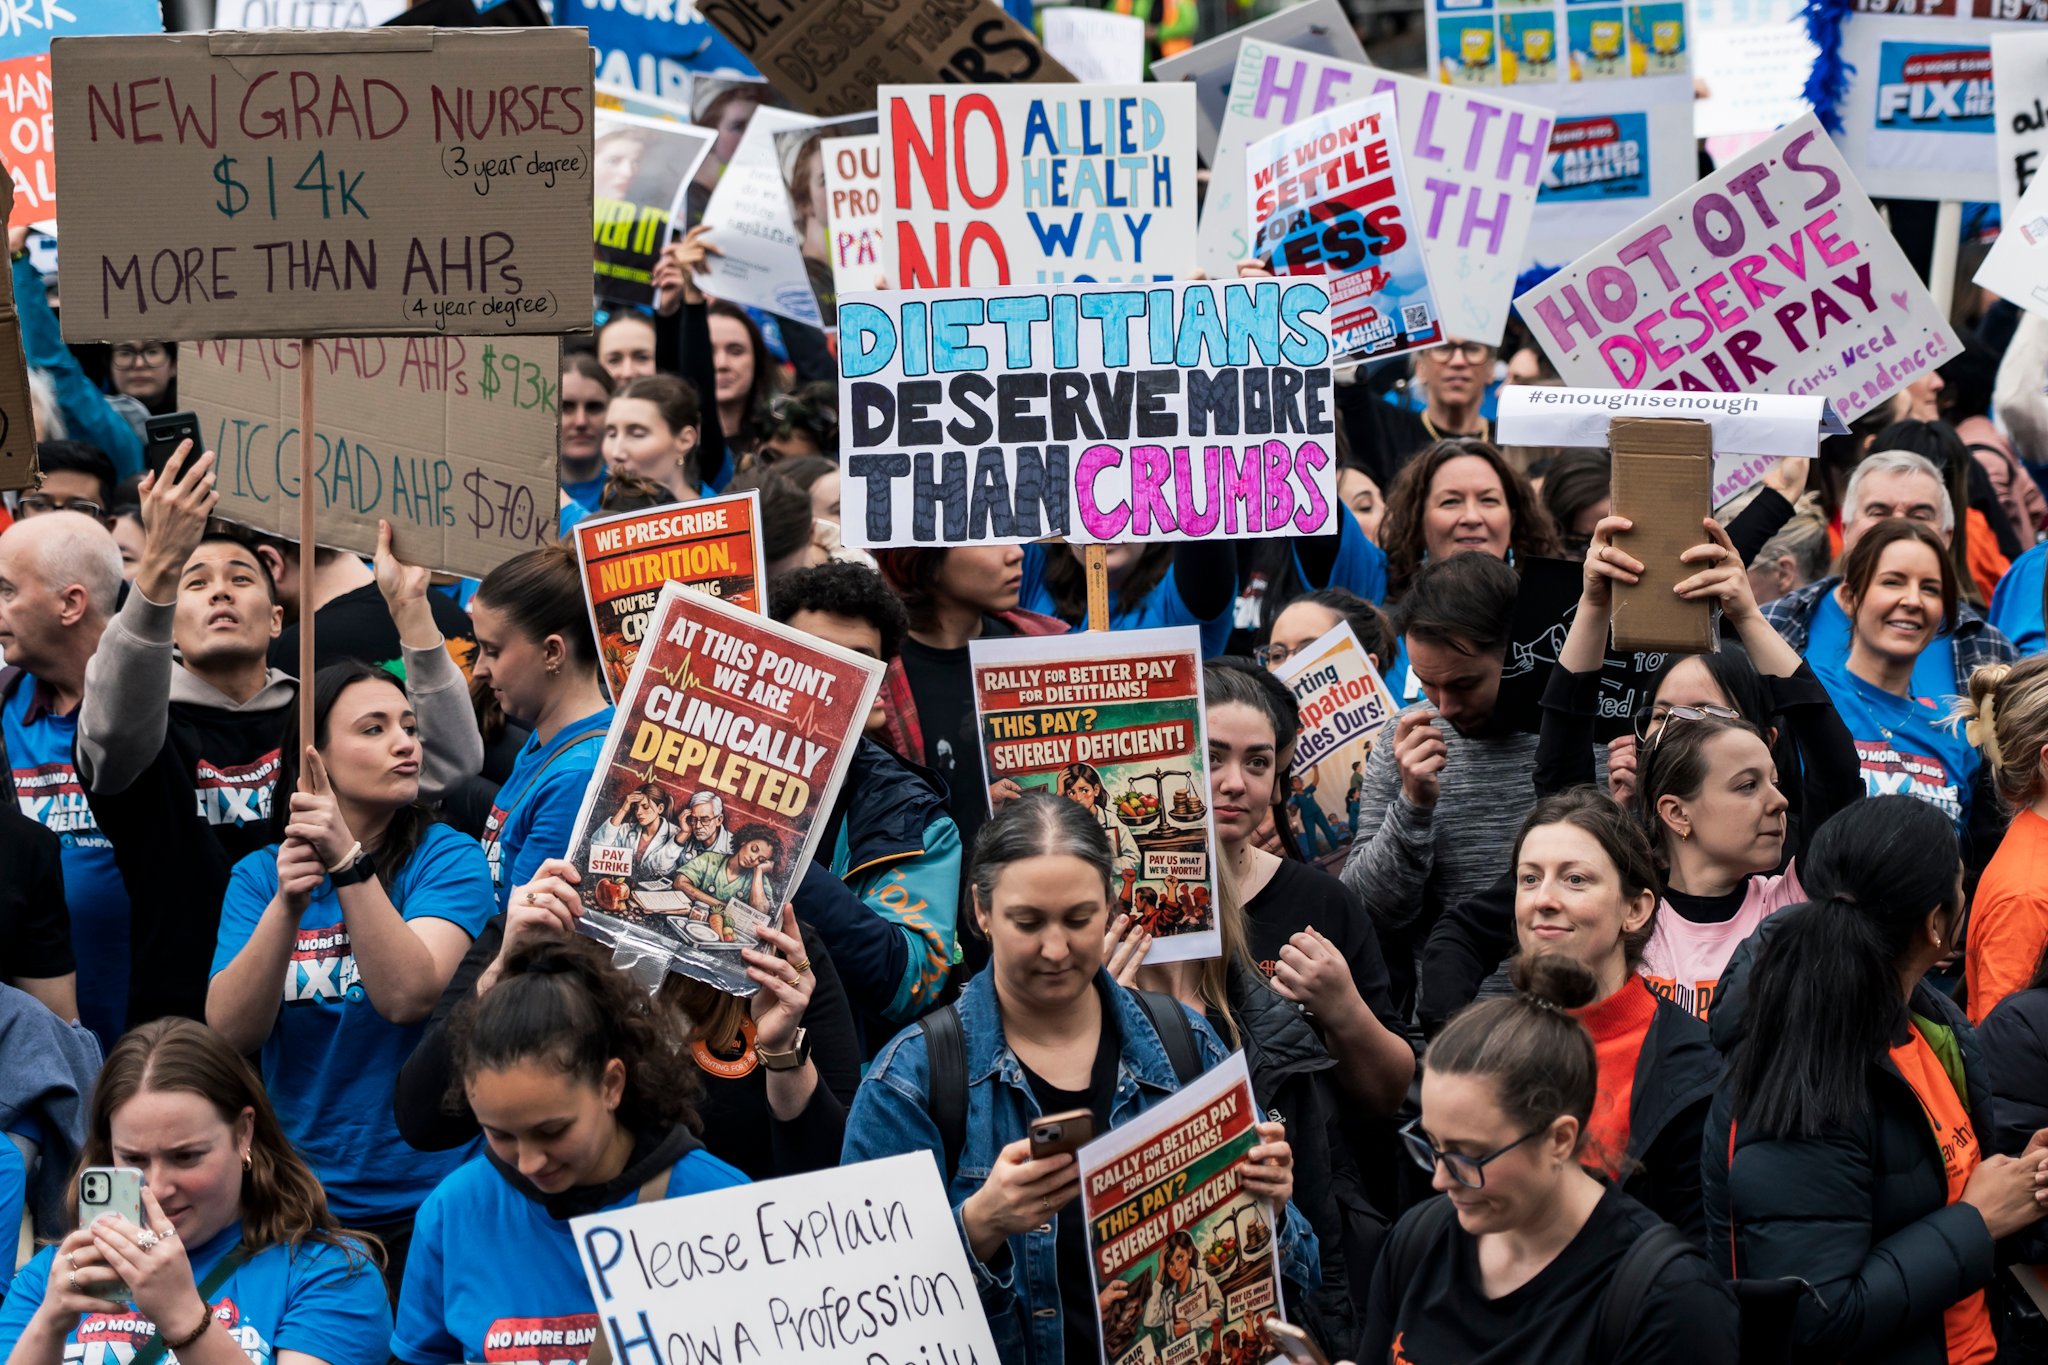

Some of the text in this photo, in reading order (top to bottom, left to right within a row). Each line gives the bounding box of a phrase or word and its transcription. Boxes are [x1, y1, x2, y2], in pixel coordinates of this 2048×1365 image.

[88, 71, 584, 149] NEW GRAD NURSES
[1879, 80, 1966, 121] FIX
[890, 93, 1009, 212] NO
[1022, 97, 1165, 158] ALLIED
[1254, 112, 1381, 191] WE WON'T
[441, 144, 588, 196] (3 year degree)
[1563, 139, 1640, 169] ALLIED
[1563, 158, 1641, 186] HEALTH
[1022, 155, 1173, 209] HEALTH
[1255, 138, 1391, 224] SETTLE
[897, 220, 1011, 288] NO
[1027, 211, 1152, 263] WAY
[1256, 209, 1307, 249] FOR
[102, 246, 237, 320] MORE
[253, 239, 378, 293] THAN
[1534, 224, 1681, 354] HOT
[1598, 209, 1860, 390] DESERVE
[403, 288, 559, 331] (4 year degree)
[840, 282, 1330, 378] DIETITIANS
[1351, 316, 1390, 339] ALLIED
[1773, 262, 1880, 353] PAY
[1352, 326, 1392, 350] HEALTH
[1841, 324, 1898, 369] Need
[851, 366, 1335, 448] DESERVE MORE
[1529, 390, 1760, 416] #enoughisenough
[848, 438, 1331, 542] THAN CRUMBS
[594, 508, 728, 552] WE PRESCRIBE
[600, 541, 738, 594] NUTRITION,
[610, 592, 656, 616] YOU'RE
[666, 616, 836, 707] AT THIS POINT,
[984, 659, 1177, 691] RALLY FOR BETTER PAY
[713, 663, 794, 714] WE ARE
[1019, 680, 1149, 704] FOR DIETITIANS!
[643, 685, 828, 779] CLINICALLY
[989, 708, 1098, 739] THIS PAY?
[1333, 694, 1386, 736] Ours!
[629, 720, 810, 818] DEPLETED
[993, 724, 1186, 771] SEVERELY DEFICIENT!
[591, 859, 630, 874] STRIKE
[602, 848, 625, 862] PAY
[1149, 855, 1201, 865] PAY US WHAT
[1170, 866, 1202, 876] WORTH!
[298, 935, 333, 951] MORE
[698, 1051, 730, 1072] FIGHTING
[731, 1063, 746, 1072] FOR
[1092, 1153, 1141, 1197] RALLY
[1143, 1142, 1162, 1164] FOR
[1162, 1115, 1209, 1152] BETTER
[1210, 1093, 1239, 1130] PAY
[1122, 1125, 1223, 1195] FOR DIETITIANS!
[1097, 1172, 1189, 1242] THIS PAY?
[584, 1198, 913, 1302] Please Explain
[1101, 1209, 1171, 1275] SEVERELY
[769, 1271, 965, 1352] Profession
[1230, 1293, 1243, 1307] PAY
[1243, 1289, 1252, 1300] US
[82, 1319, 157, 1336] NO MORE
[487, 1332, 512, 1349] NO
[514, 1329, 563, 1347] MORE
[1166, 1338, 1191, 1358] RESPECT
